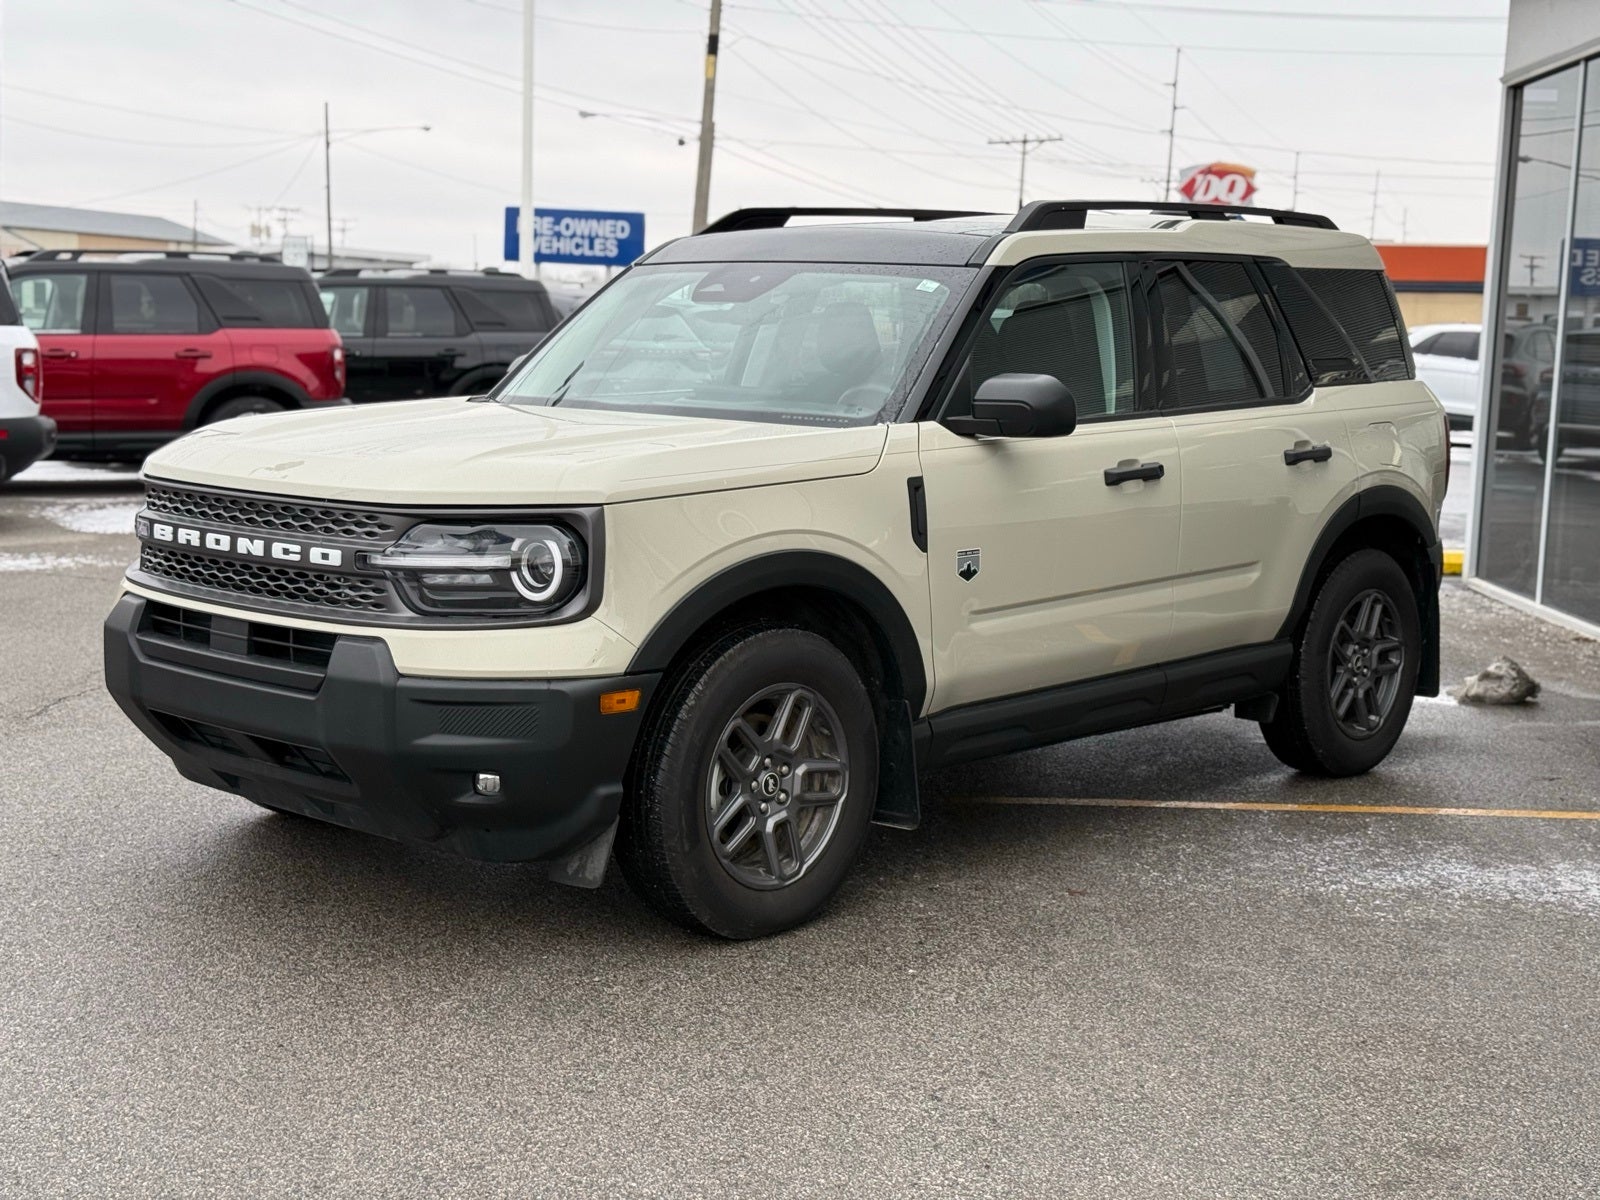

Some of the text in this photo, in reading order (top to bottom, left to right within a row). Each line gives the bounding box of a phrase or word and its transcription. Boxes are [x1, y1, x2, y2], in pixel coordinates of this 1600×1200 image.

[1191, 172, 1248, 205] DQ
[516, 216, 631, 239] RE-OWNED
[153, 523, 342, 567] BRONCO
